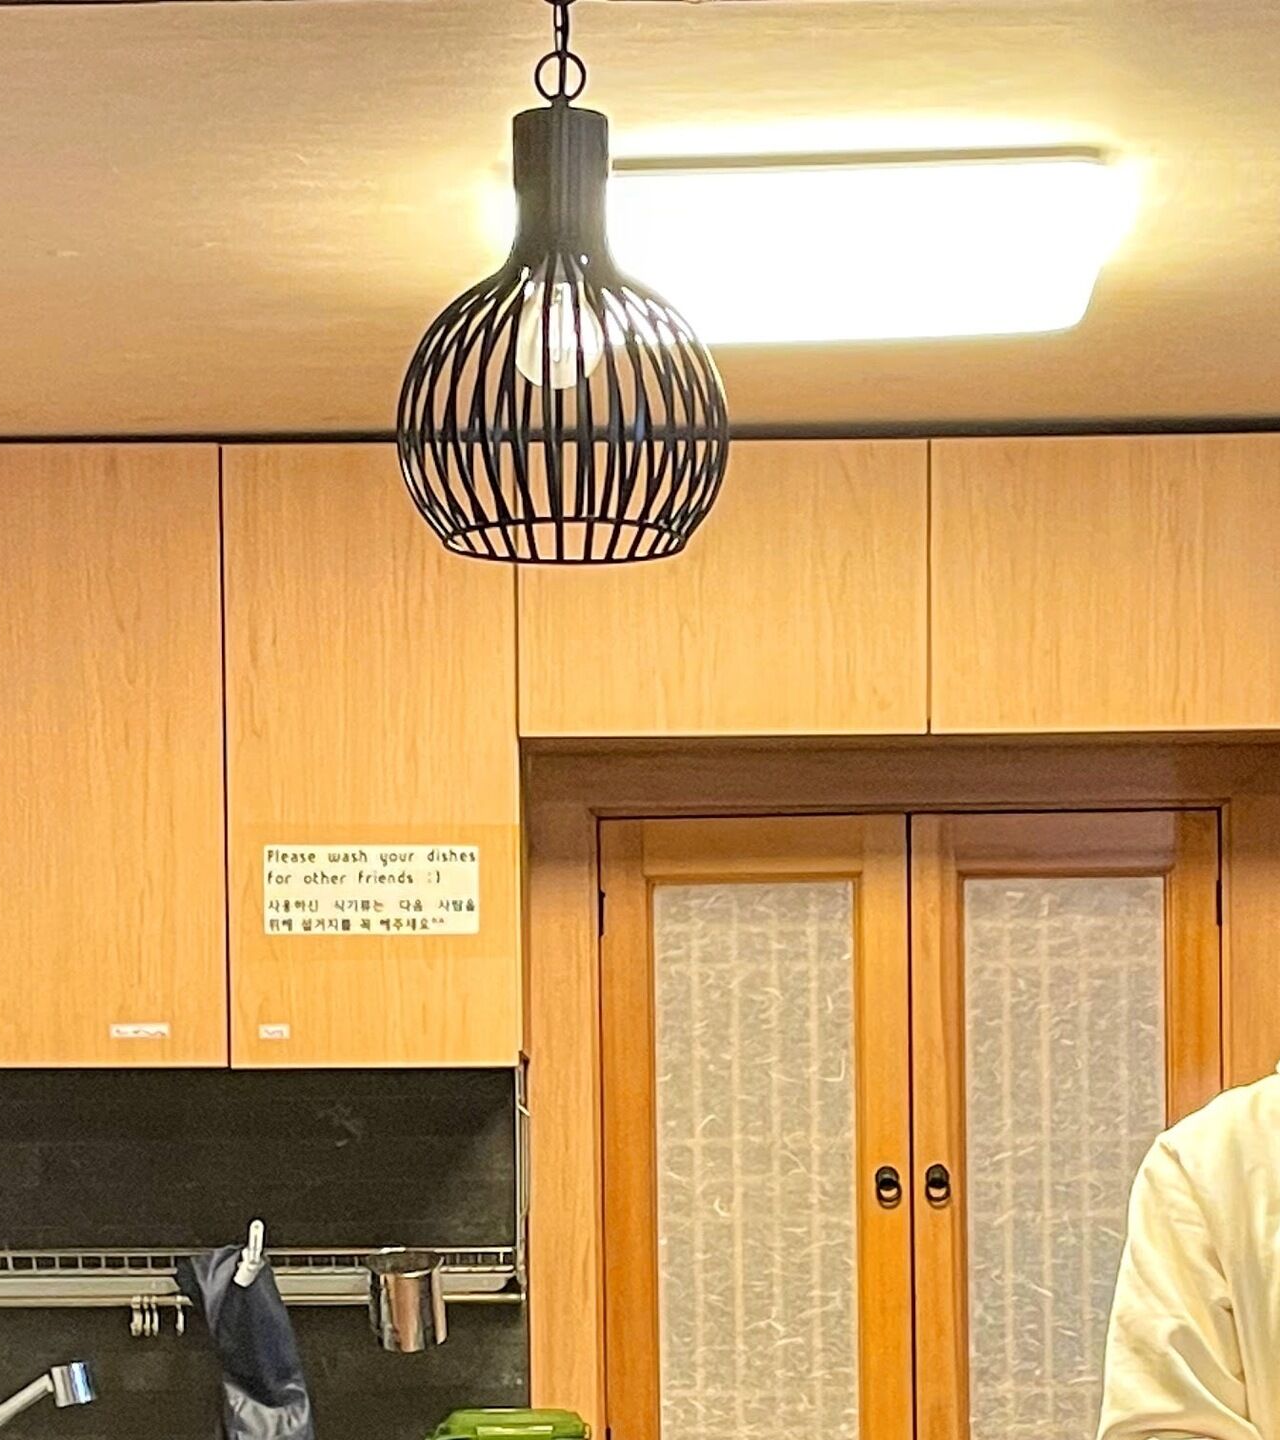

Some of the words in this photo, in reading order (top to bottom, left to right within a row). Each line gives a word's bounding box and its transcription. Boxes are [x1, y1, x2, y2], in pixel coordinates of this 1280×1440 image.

[267, 849, 316, 863] Please
[328, 849, 368, 863] wash
[380, 852, 415, 867] your
[427, 849, 475, 862] dishes
[267, 870, 292, 884] for
[303, 870, 346, 884] other
[358, 870, 413, 884] friends
[268, 899, 318, 913] 사용하신
[399, 898, 423, 912] 다음
[438, 898, 475, 912] 사람을
[269, 918, 292, 932] 위해
[301, 918, 351, 932] 설거지를
